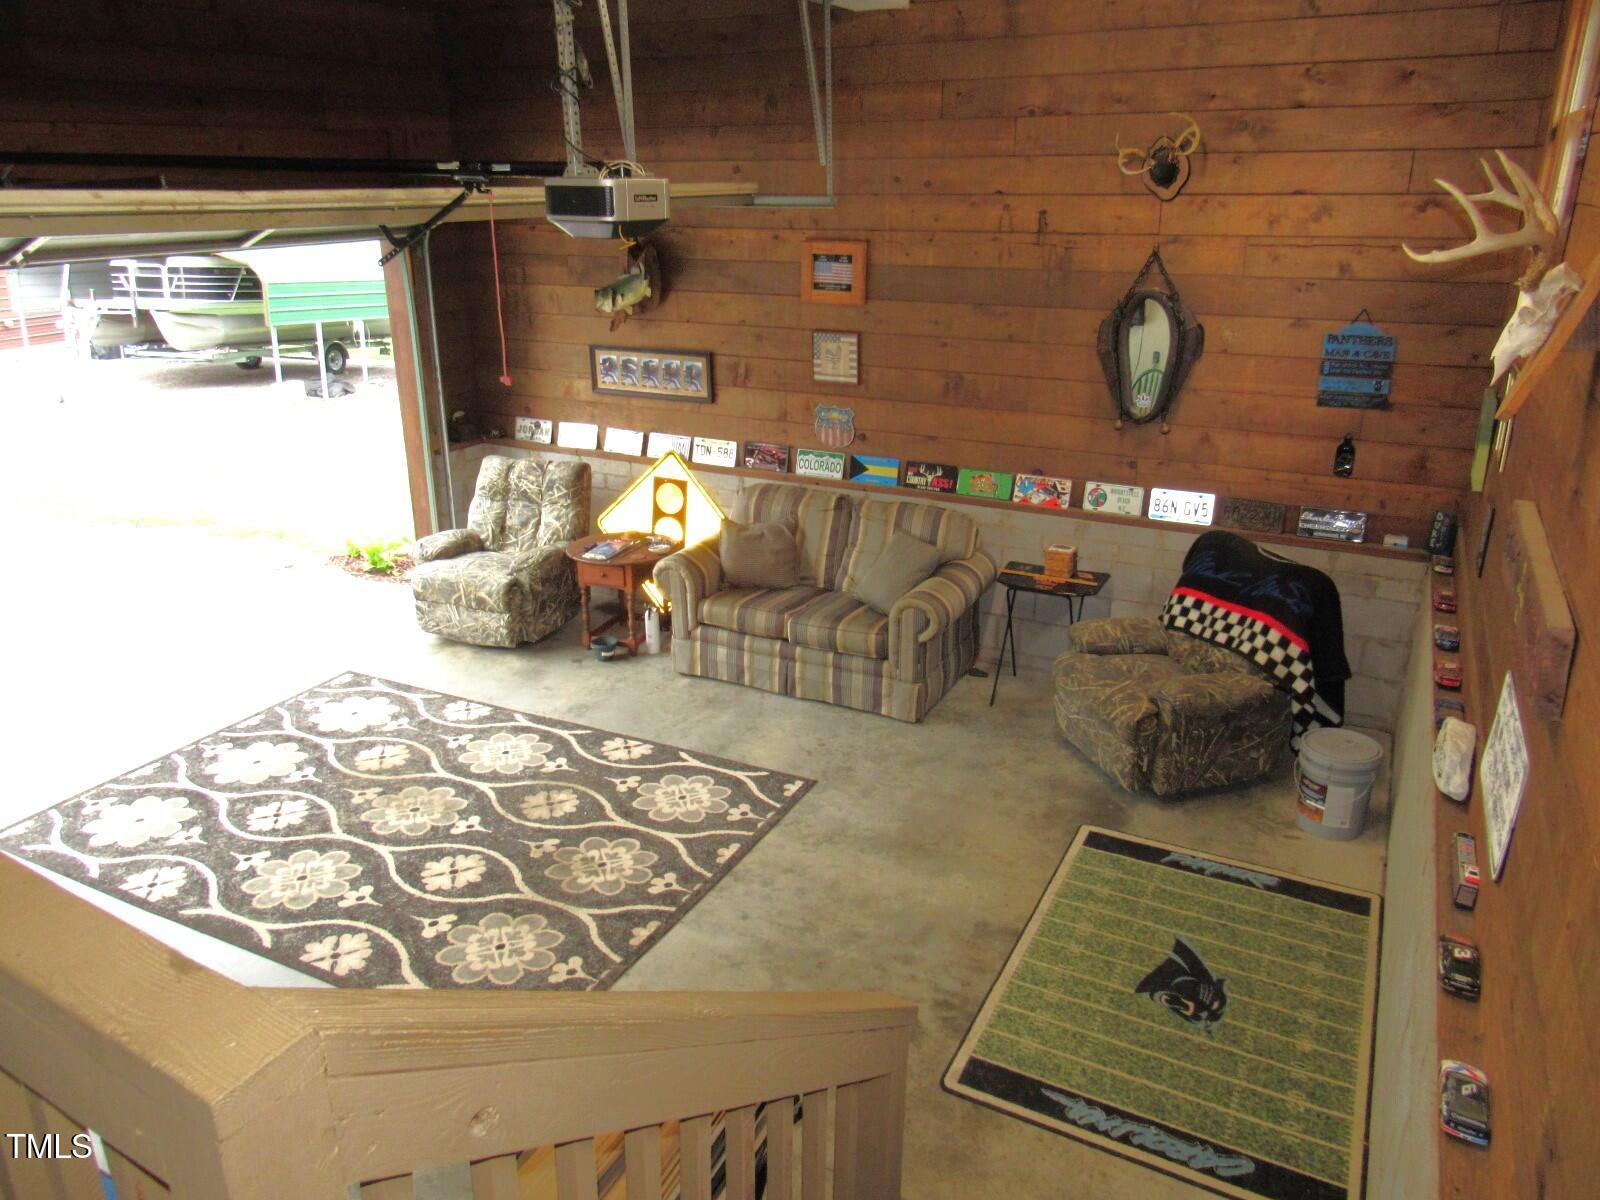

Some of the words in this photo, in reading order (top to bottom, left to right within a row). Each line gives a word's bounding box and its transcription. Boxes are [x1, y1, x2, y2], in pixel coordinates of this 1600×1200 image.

[1327, 334, 1393, 347] PANTHERS
[798, 458, 842, 474] COLORADO
[1154, 498, 1178, 514] 86N
